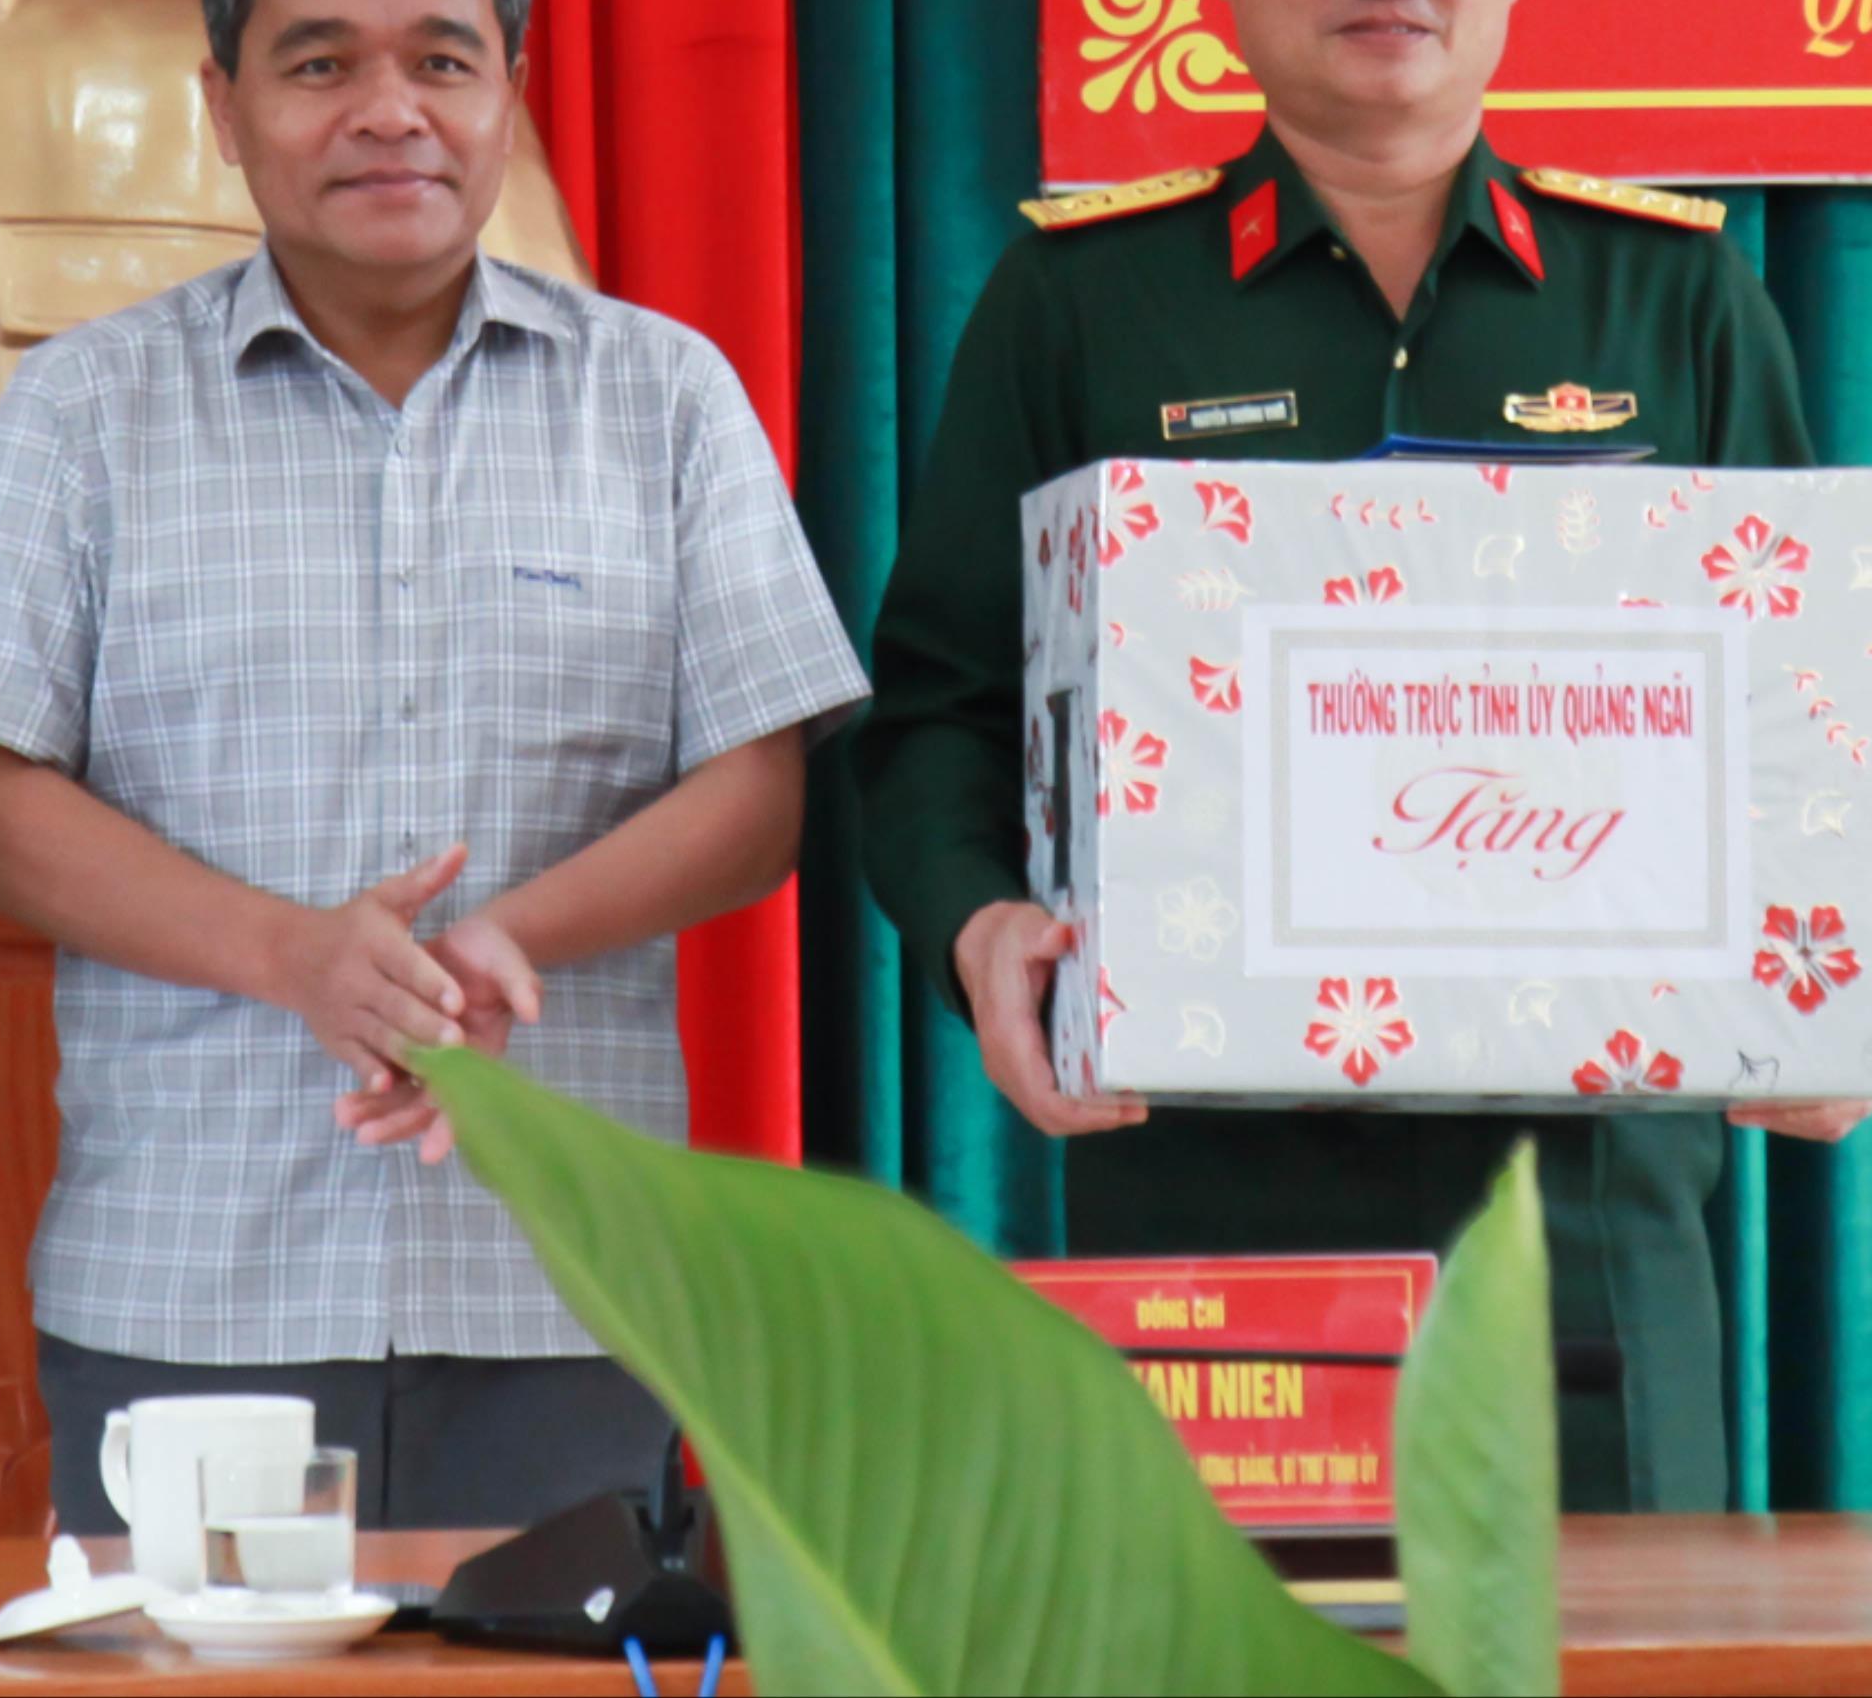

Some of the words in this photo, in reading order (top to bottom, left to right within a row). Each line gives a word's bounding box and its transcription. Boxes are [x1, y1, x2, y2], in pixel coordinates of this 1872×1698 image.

[1308, 669, 1397, 735] THƯỜNG
[1404, 673, 1462, 749] TRỰC
[1469, 663, 1520, 735] TỈNH
[1528, 663, 1556, 735] ỦY
[1563, 663, 1635, 746] QUẢNG
[1643, 672, 1694, 736] NGÃI
[1372, 766, 1626, 881] Tặng
